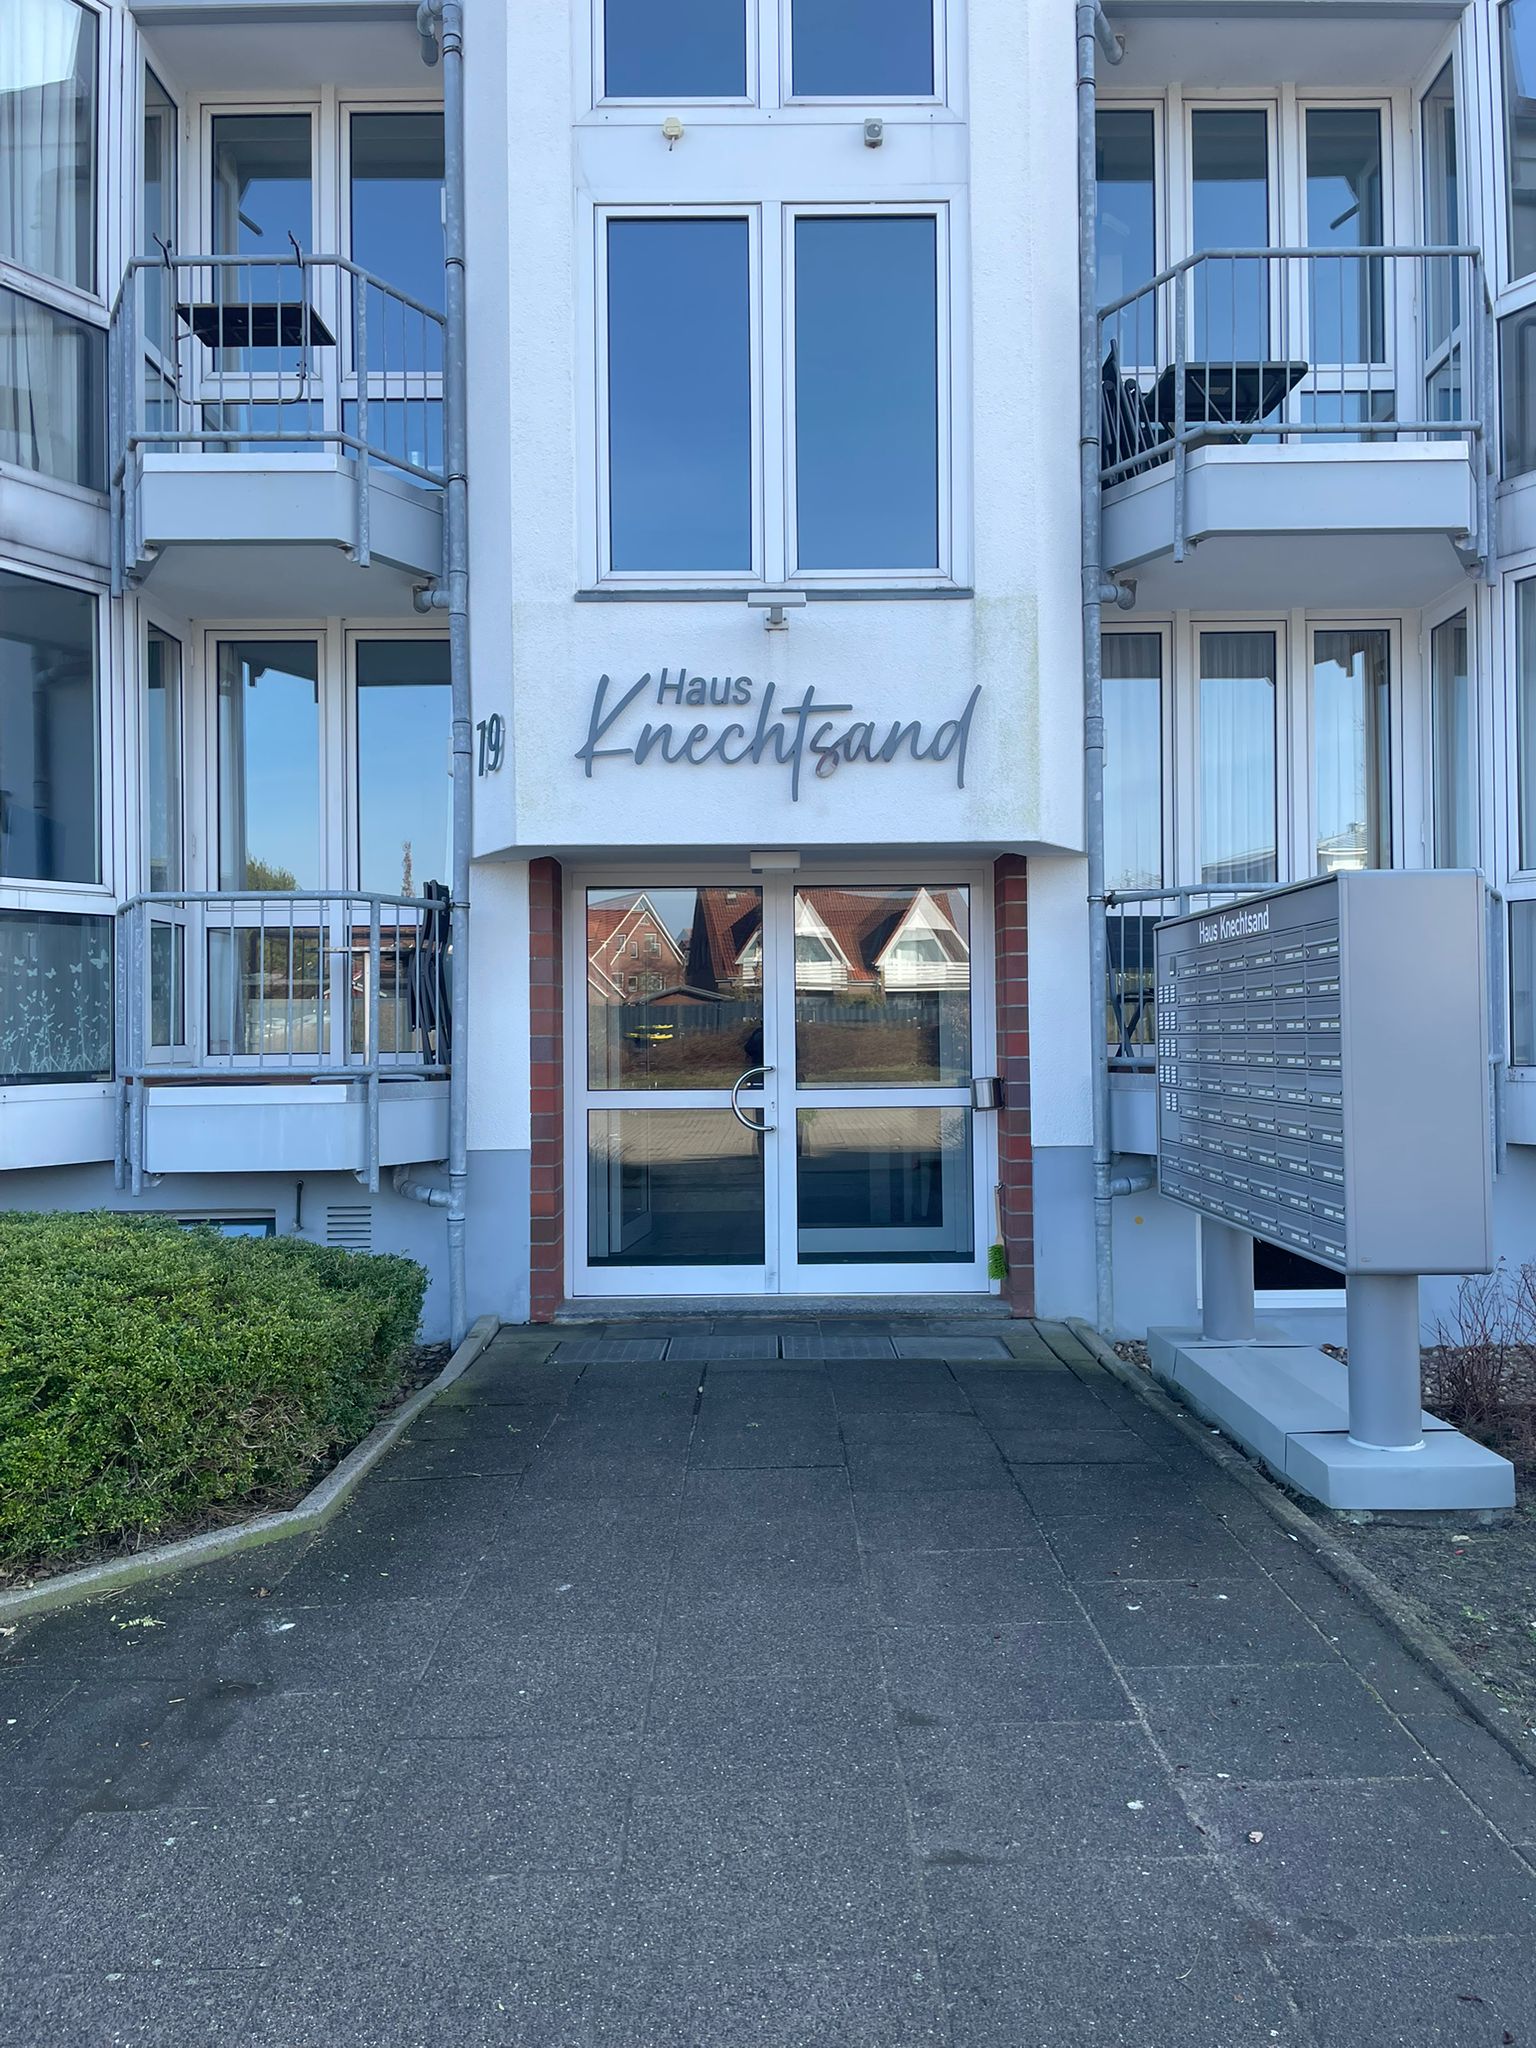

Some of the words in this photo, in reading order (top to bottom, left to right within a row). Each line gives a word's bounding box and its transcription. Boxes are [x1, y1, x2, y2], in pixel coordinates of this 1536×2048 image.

[658, 667, 753, 705] Haus
[476, 713, 501, 777] 19
[575, 673, 982, 802] Knechtsand
[1199, 922, 1218, 944] Haus
[1220, 904, 1269, 939] Knechtsand
